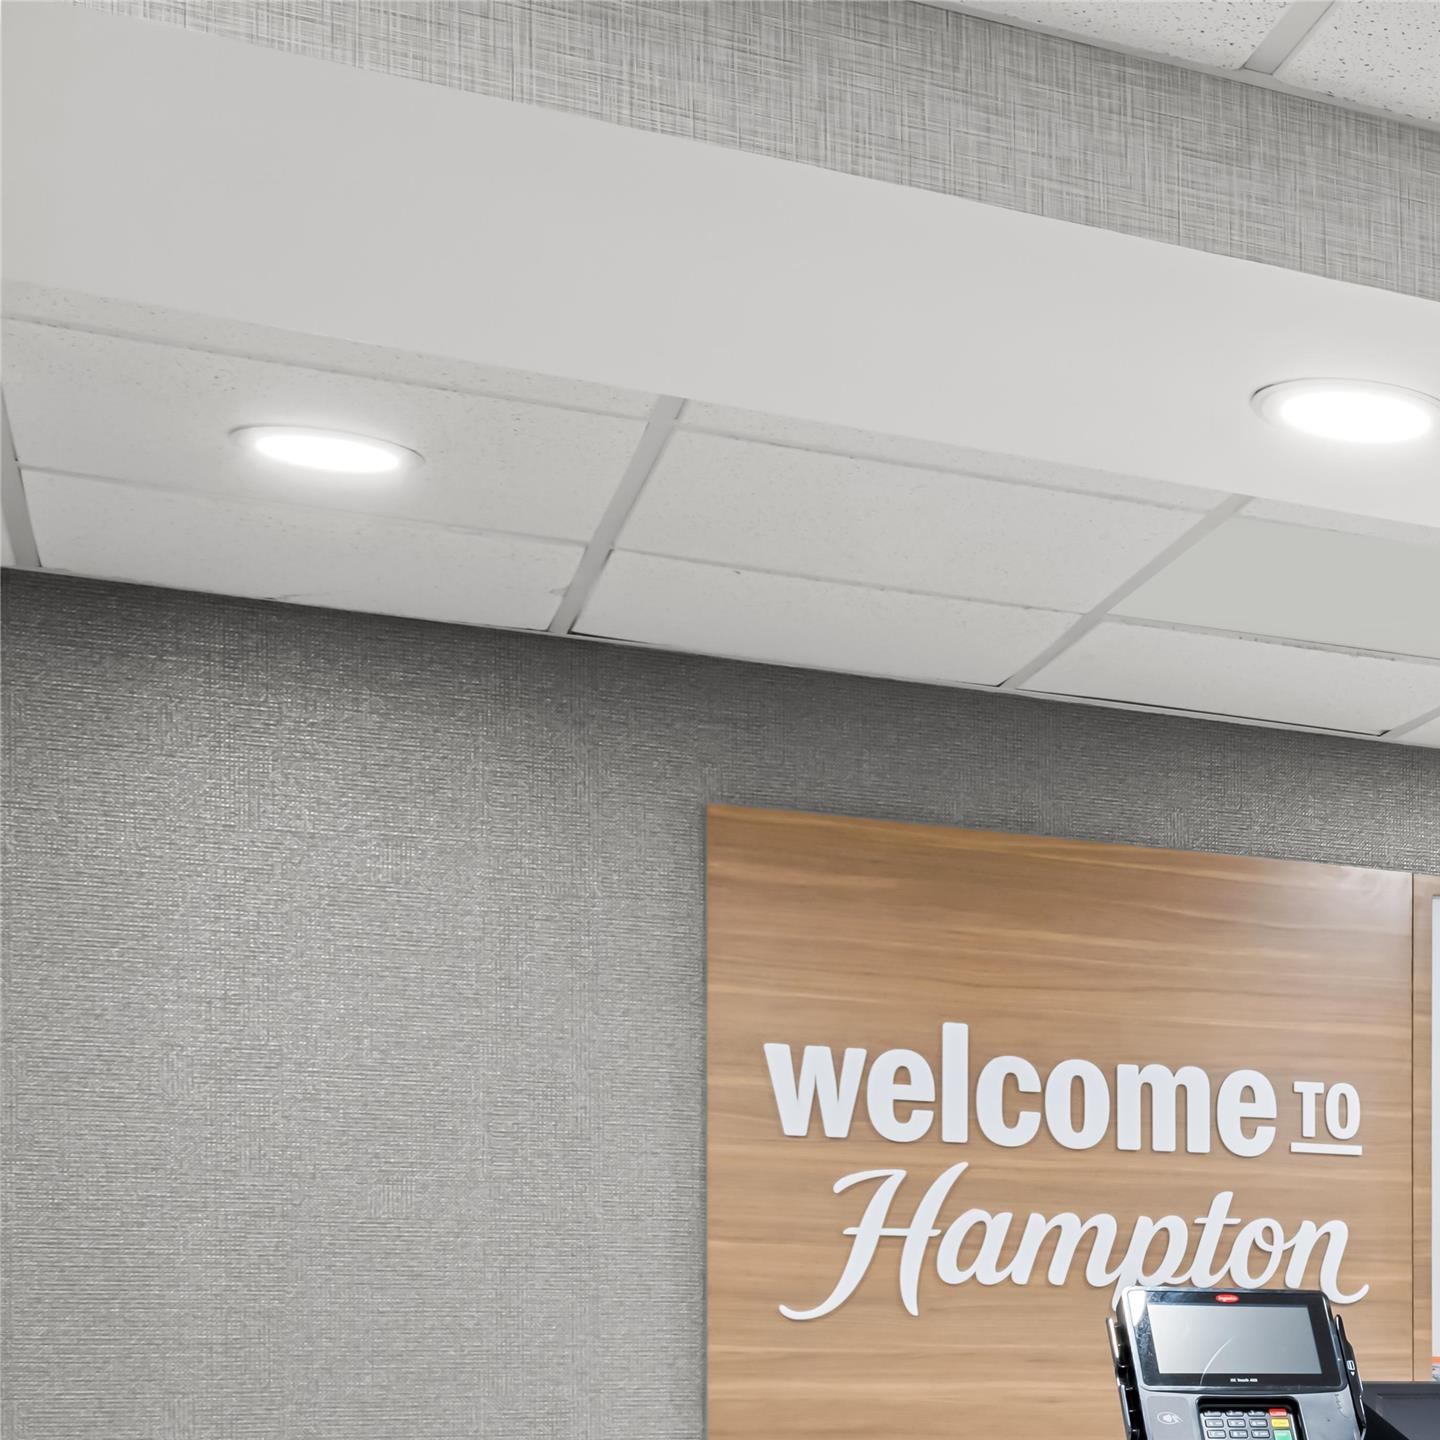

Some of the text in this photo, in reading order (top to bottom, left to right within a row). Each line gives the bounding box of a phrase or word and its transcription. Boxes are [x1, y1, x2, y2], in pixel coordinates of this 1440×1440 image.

[764, 1022, 1361, 1157] welcome TO
[778, 1161, 1370, 1321] Hampton
